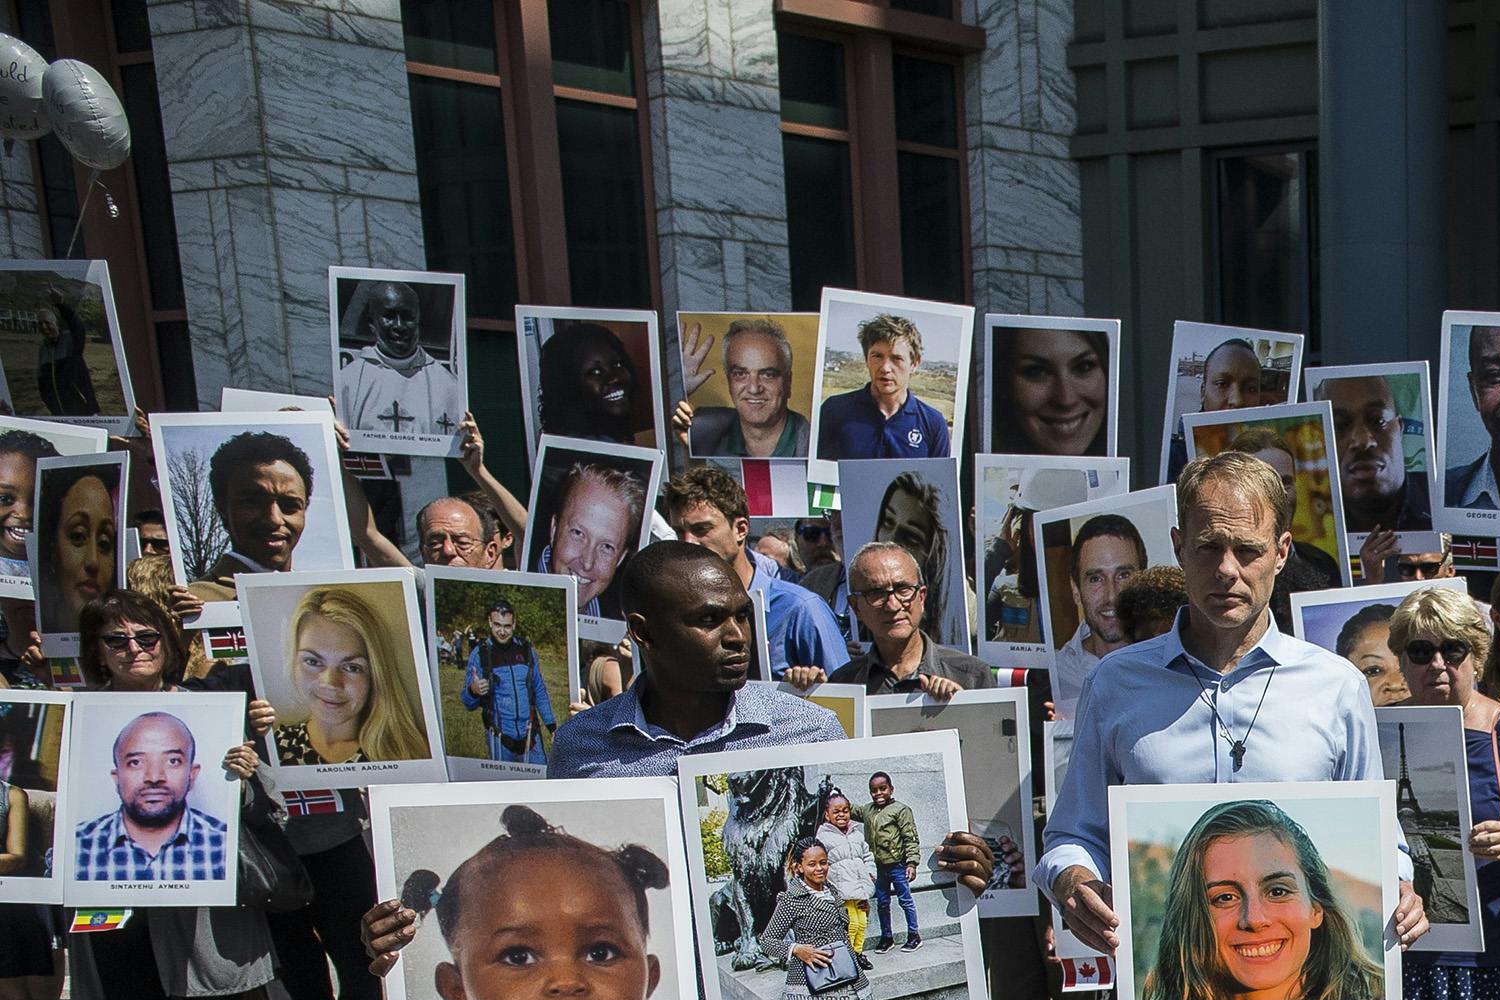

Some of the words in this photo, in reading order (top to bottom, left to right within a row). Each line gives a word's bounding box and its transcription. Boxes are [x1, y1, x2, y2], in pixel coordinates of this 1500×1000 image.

[1466, 512, 1497, 520] GEORGE
[361, 763, 400, 771] AADLAND
[480, 762, 507, 771] SERGEI
[509, 766, 542, 774] VIALIKOV
